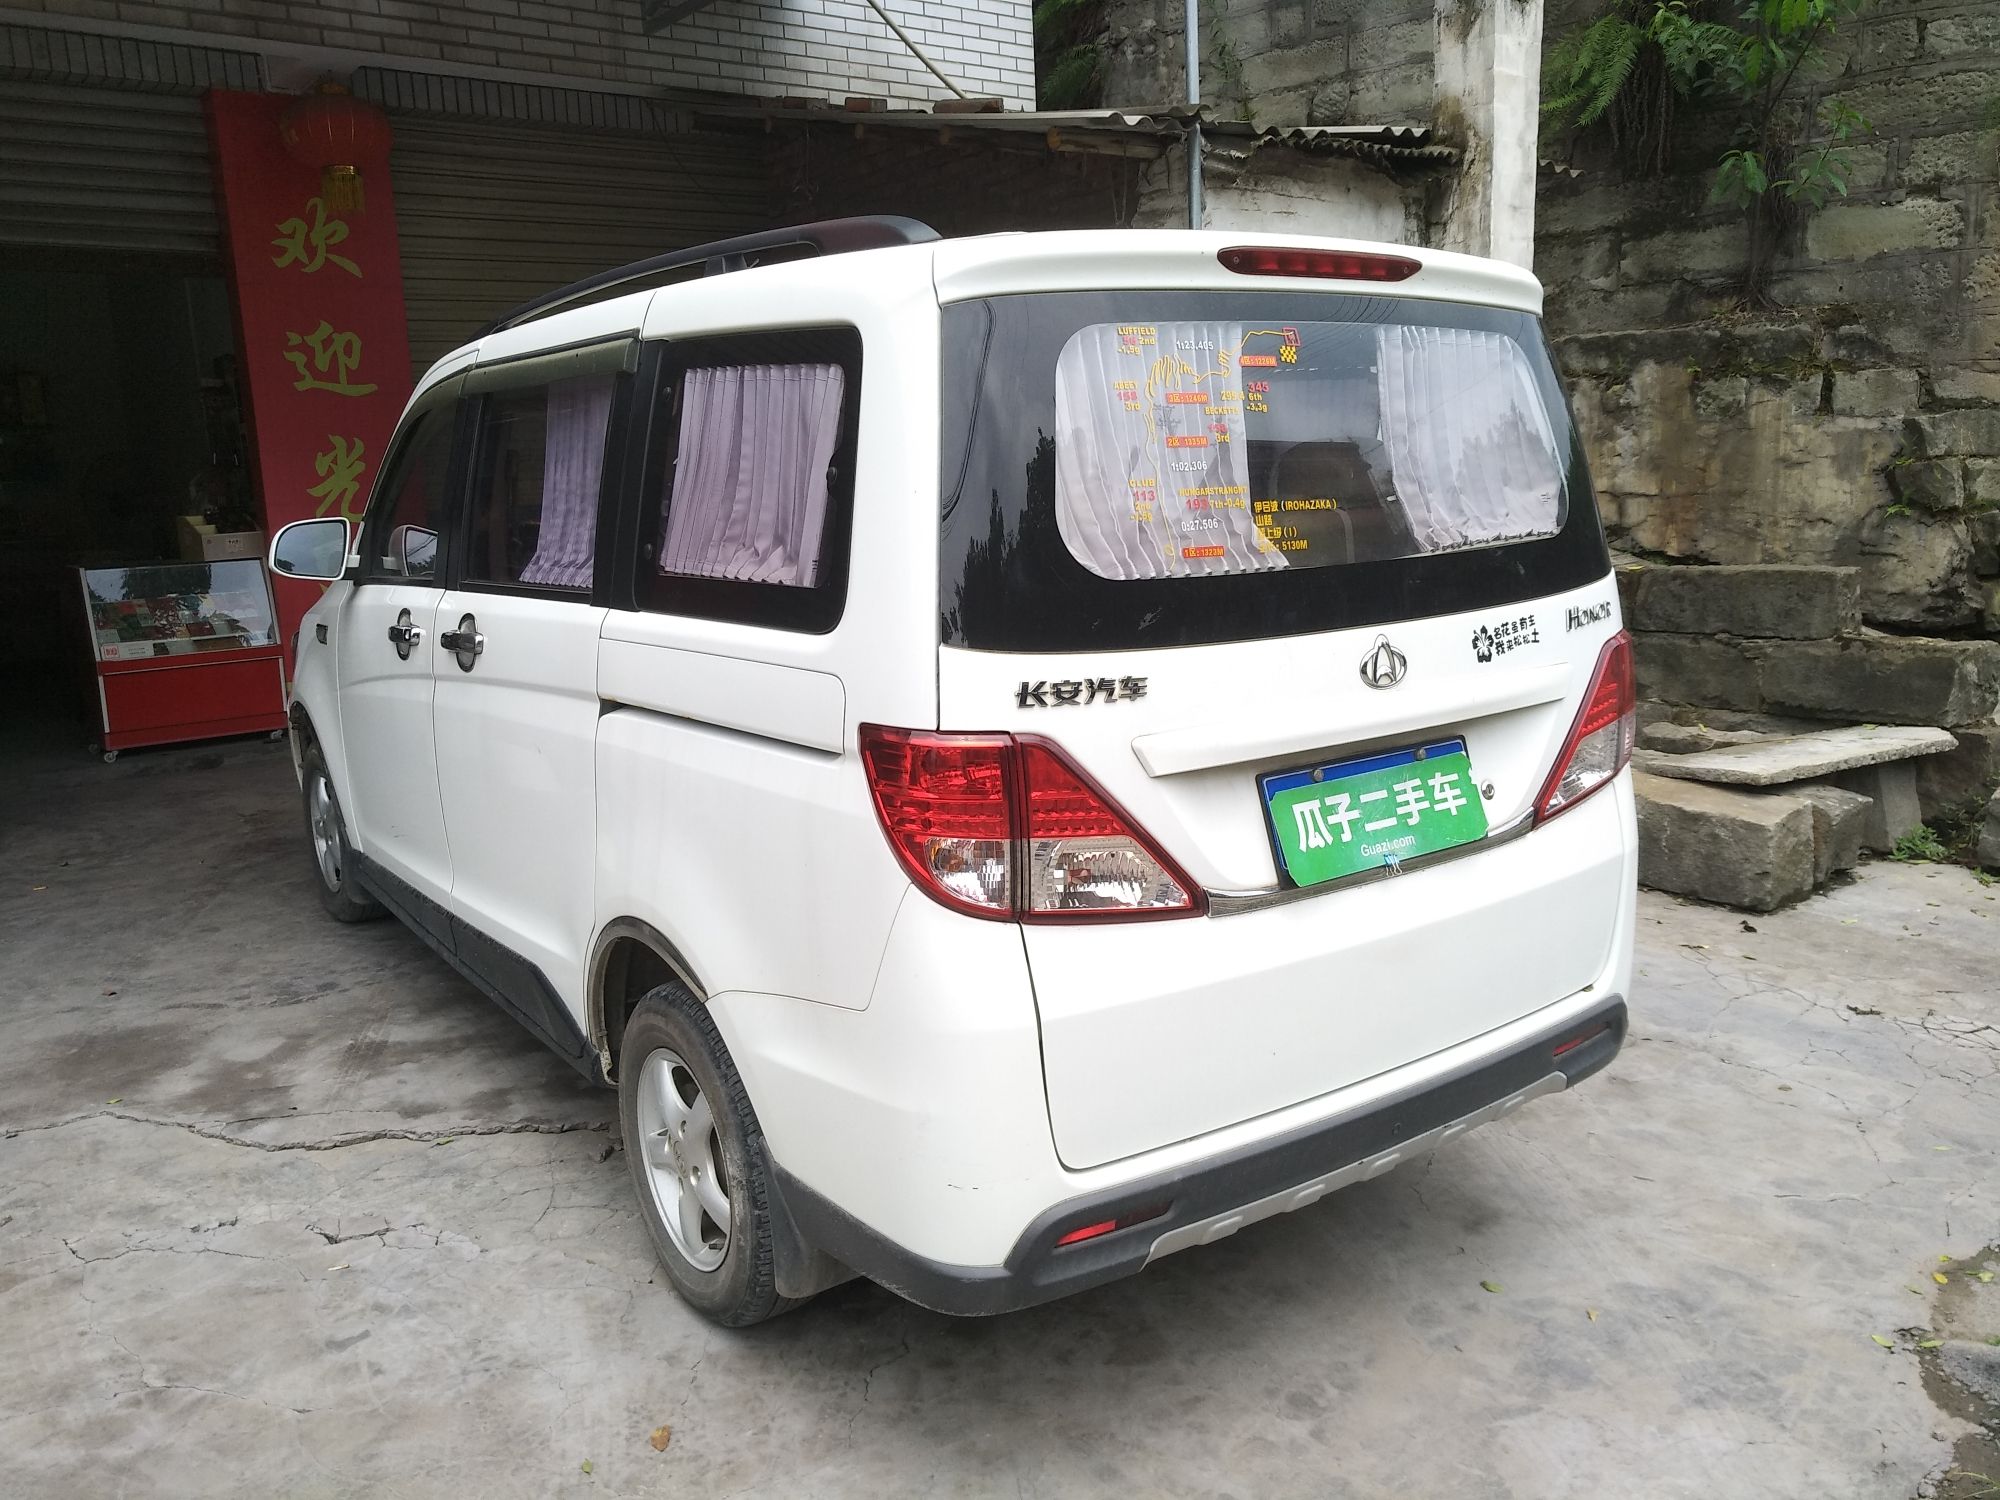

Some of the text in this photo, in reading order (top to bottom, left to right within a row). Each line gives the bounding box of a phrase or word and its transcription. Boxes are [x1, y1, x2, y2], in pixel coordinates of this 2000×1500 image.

[1117, 326, 1156, 336] LUFFIELD
[1139, 337, 1156, 345] 2nd
[1176, 340, 1214, 350] 1:23.405
[272, 197, 378, 523] 欢迎光
[1247, 382, 1270, 392] 345
[1248, 393, 1263, 401] 6th
[1124, 402, 1141, 412] 3rd
[1215, 432, 1231, 443] 3rd
[1171, 461, 1208, 471] 1:02.306
[1133, 490, 1156, 501] 113
[1181, 519, 1219, 531] 0:27.506
[1493, 614, 1536, 640] 名花虽有主
[1494, 627, 1540, 656] 我来松松土
[1015, 676, 1148, 707] 长安汽车
[1291, 772, 1467, 852] 瓜子二手车
[1360, 834, 1416, 857] Guazi.com
